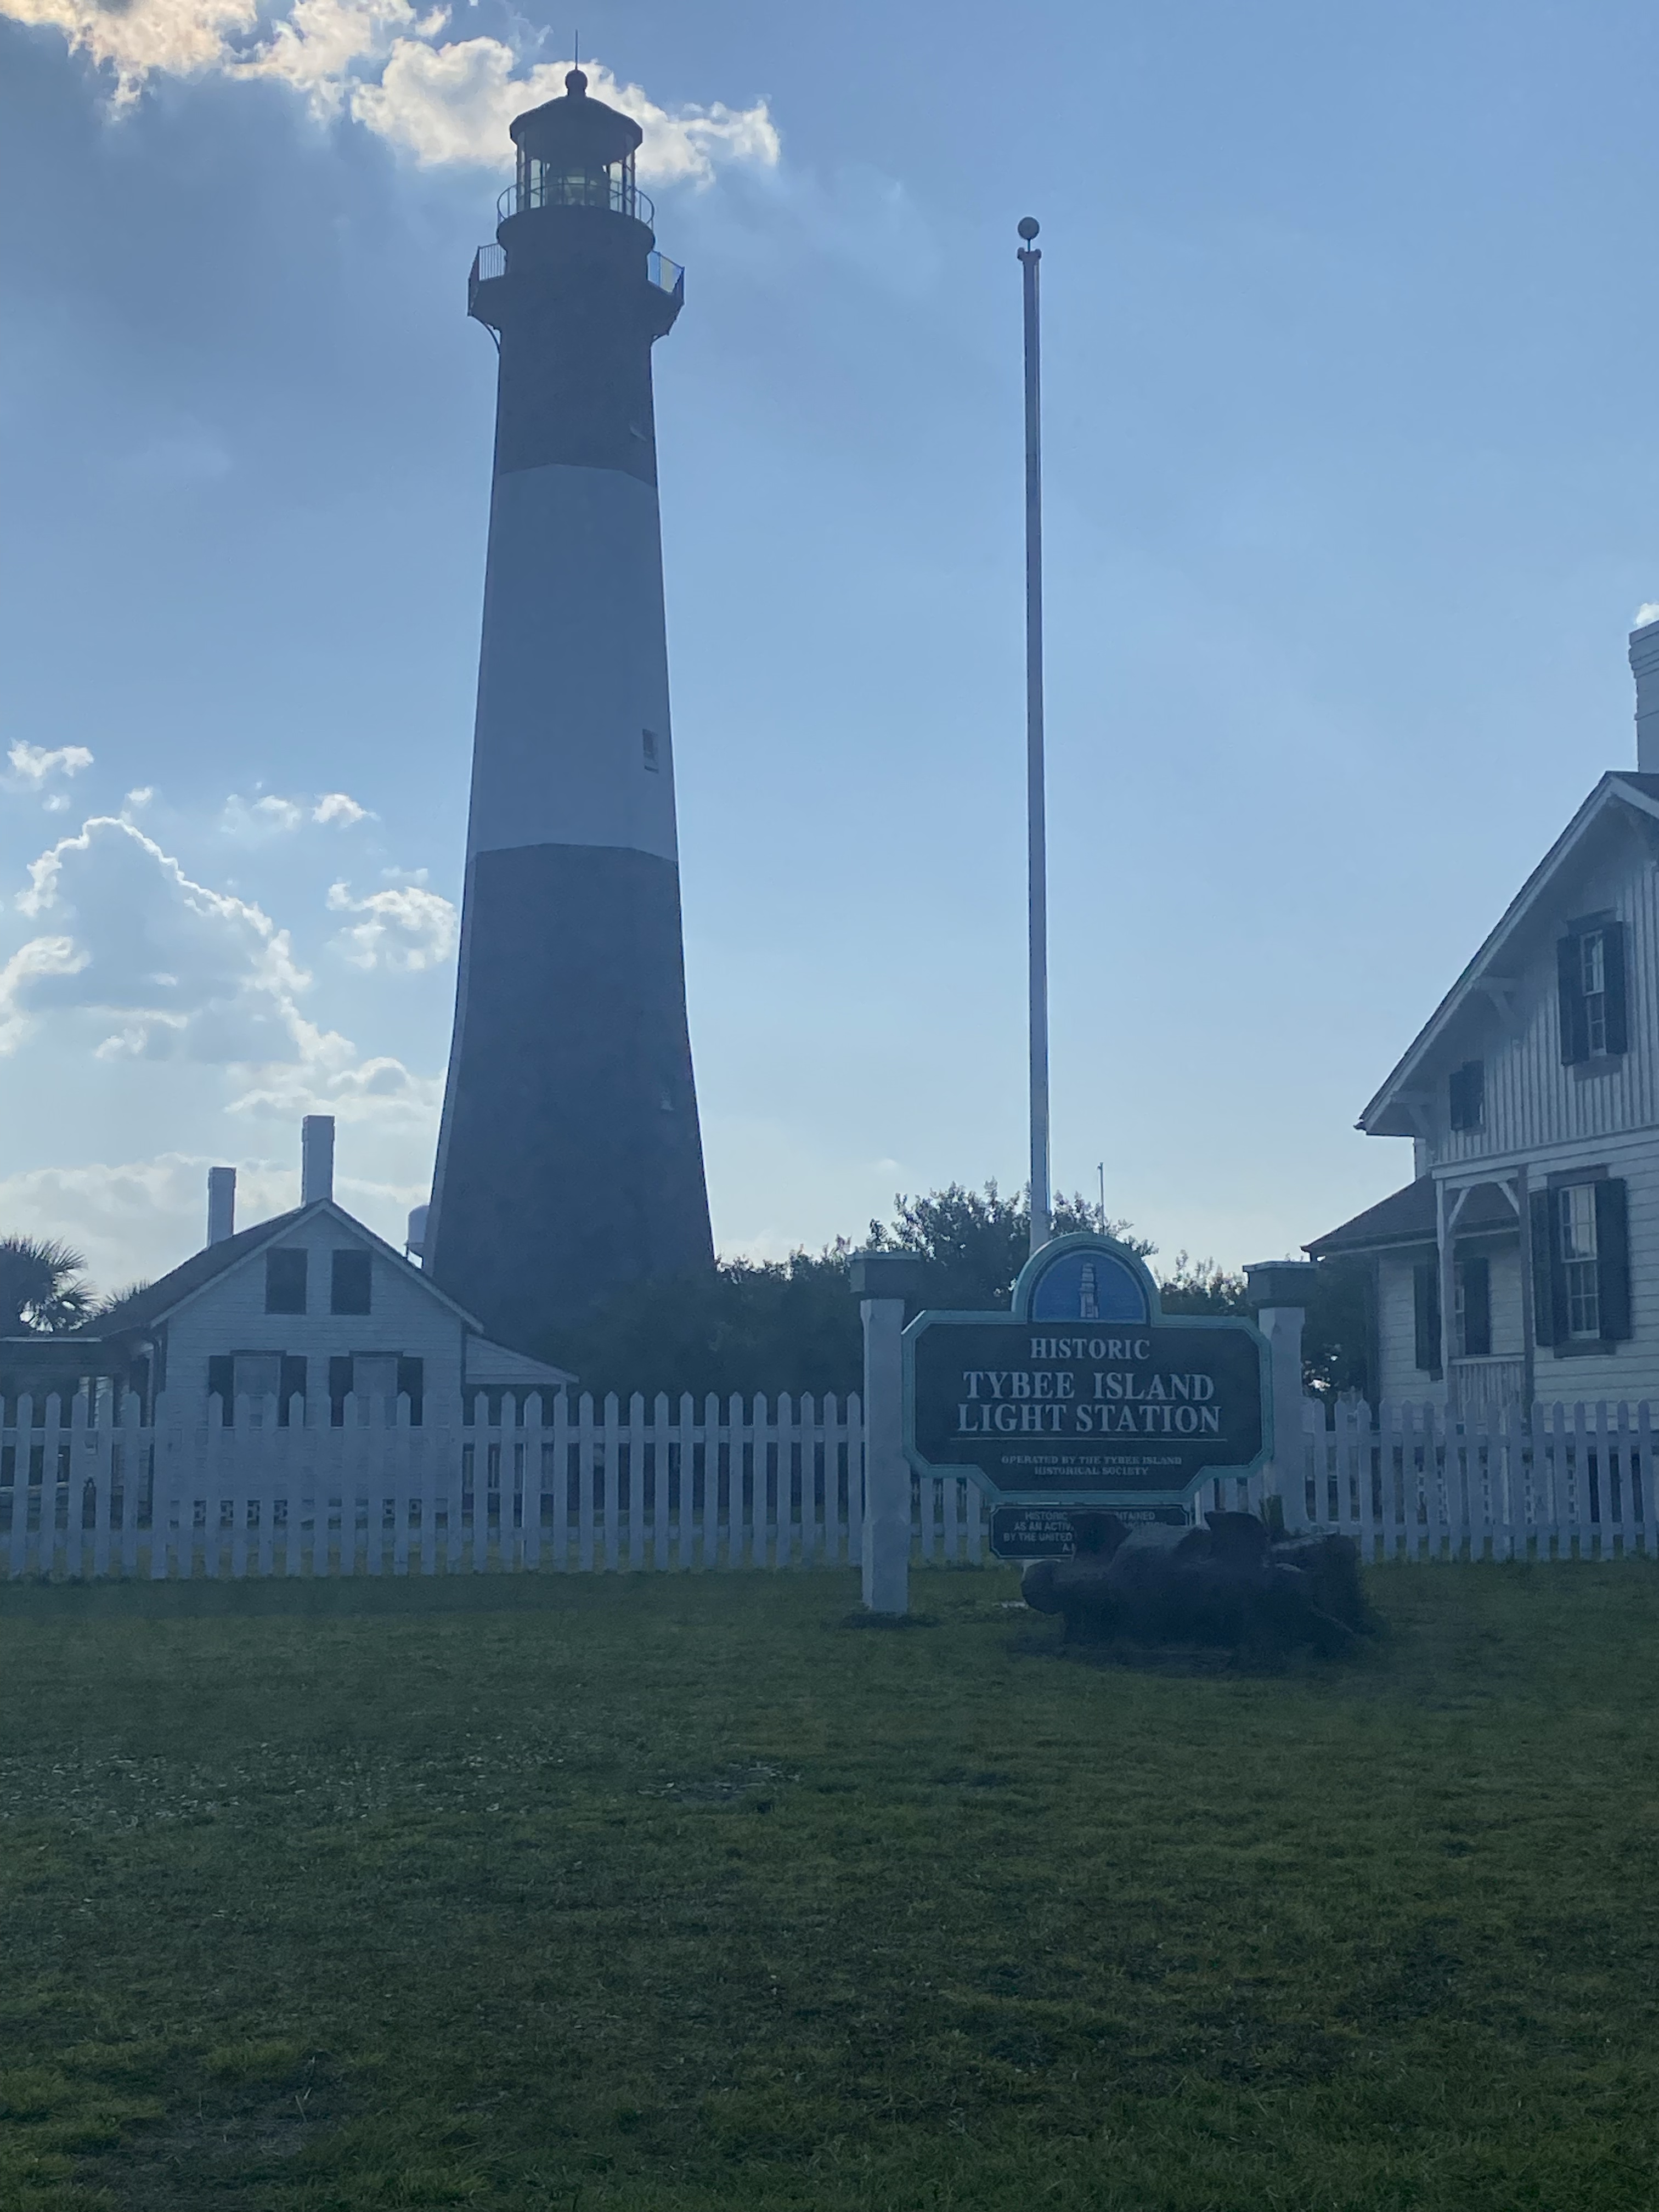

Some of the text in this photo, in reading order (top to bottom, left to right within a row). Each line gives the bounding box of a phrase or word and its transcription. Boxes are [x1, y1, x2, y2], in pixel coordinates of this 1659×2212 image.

[1030, 1338, 1150, 1360] HISTORIC
[962, 1370, 1215, 1401] TYBEE ISLAND
[957, 1403, 1221, 1434] LIGHT STATION
[1001, 1455, 1182, 1465] OPERATED BY THE TYBEE ISLAND
[1034, 1466, 1149, 1476] HISTORICAL SOCIETY
[1025, 1511, 1068, 1521] HISTORIC
[1014, 1521, 1026, 1531] AS
[1028, 1521, 1042, 1531] AN
[1003, 1532, 1073, 1542] BY THE UNITED
